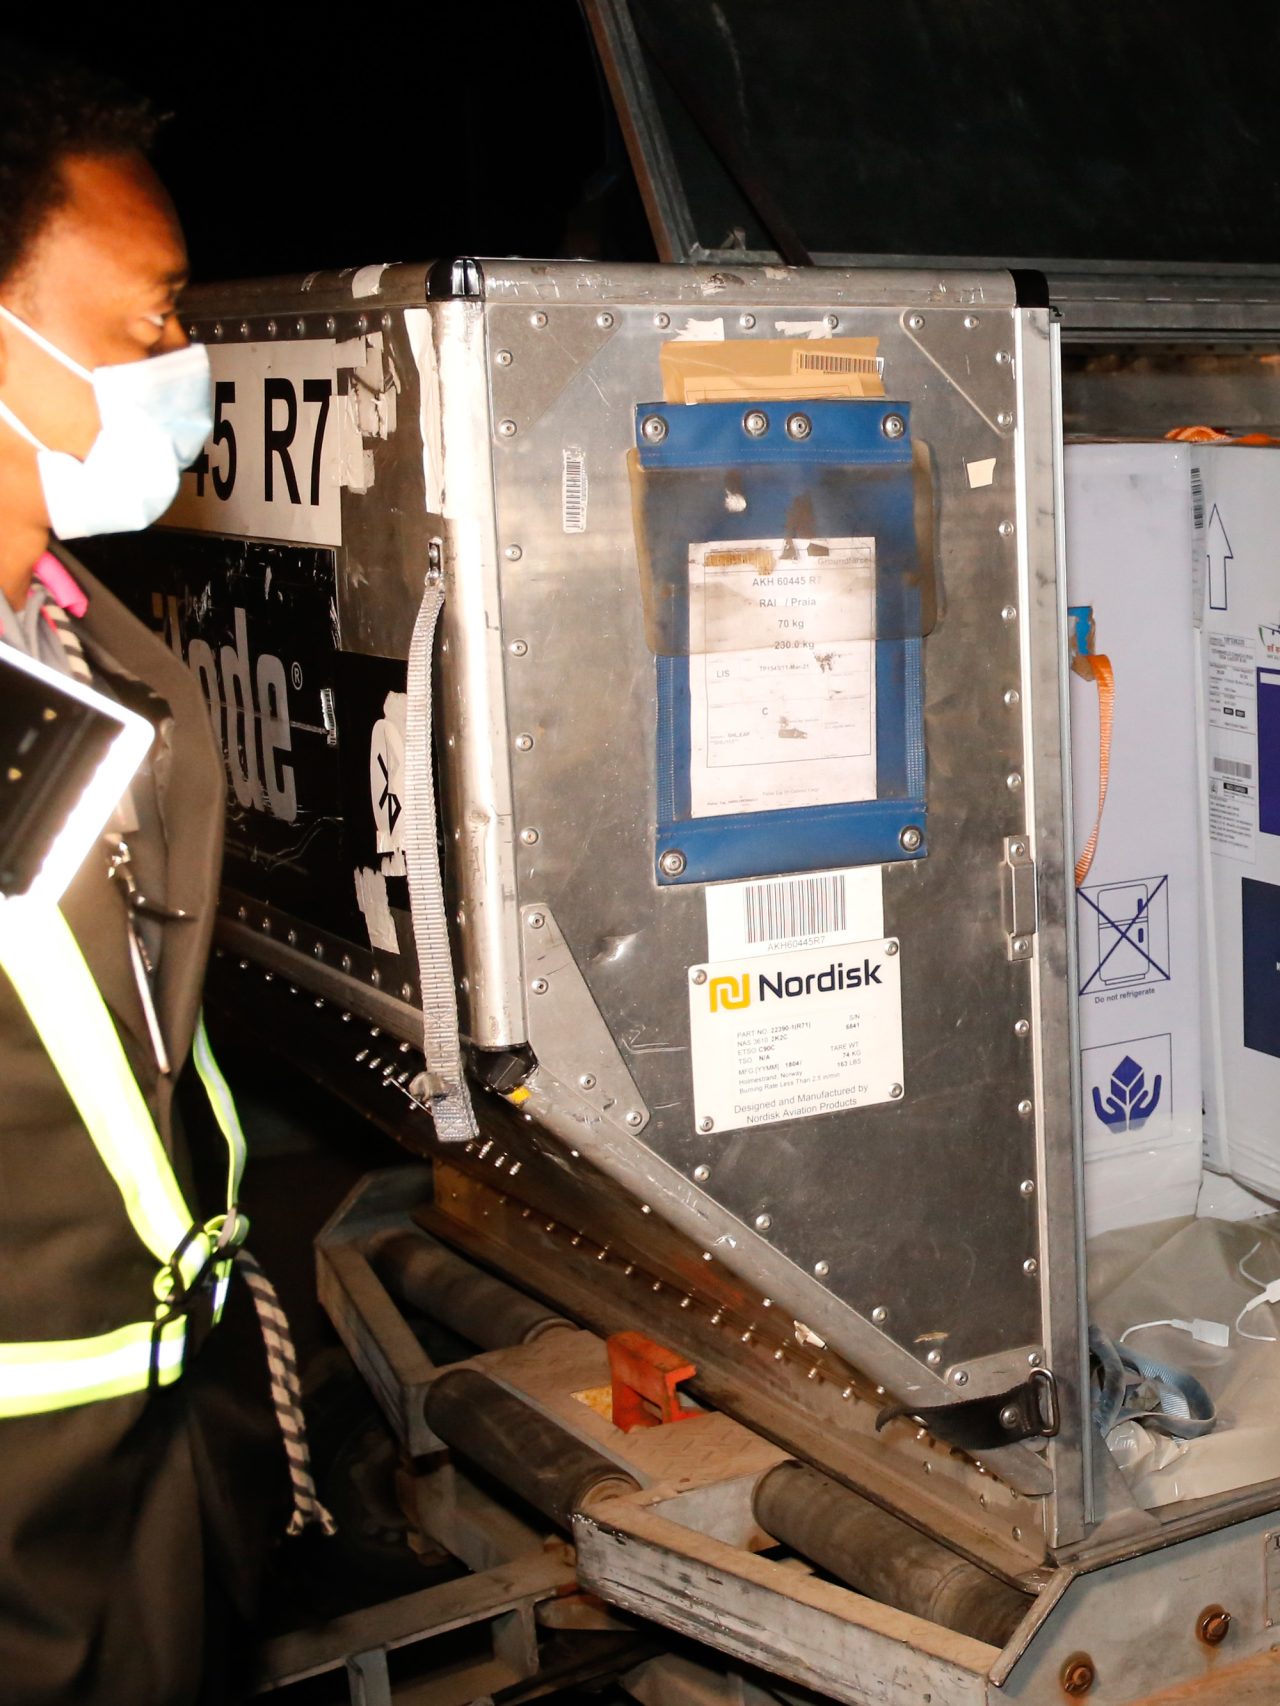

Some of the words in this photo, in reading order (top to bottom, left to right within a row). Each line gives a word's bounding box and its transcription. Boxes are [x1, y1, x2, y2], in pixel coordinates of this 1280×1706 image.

[264, 377, 332, 506] R7
[752, 576, 776, 588] AKH
[777, 575, 806, 586] 60445
[791, 597, 817, 608] Praia
[778, 619, 789, 629] 70
[791, 619, 805, 630] kg
[802, 640, 815, 651] kg
[716, 669, 731, 679] LIS
[767, 935, 827, 952] AKH60445R7
[759, 958, 883, 1002] Nordisk
[1094, 996, 1105, 1004] Do
[1106, 994, 1118, 1003] not
[1119, 988, 1155, 999] refrigerate
[734, 1099, 776, 1115] Designed
[778, 1096, 796, 1106] and
[797, 1085, 856, 1102] Manufactured
[858, 1084, 869, 1094] by
[746, 1110, 781, 1124] Nordisk
[782, 1105, 818, 1118] Aviation
[819, 1097, 857, 1111] Products
